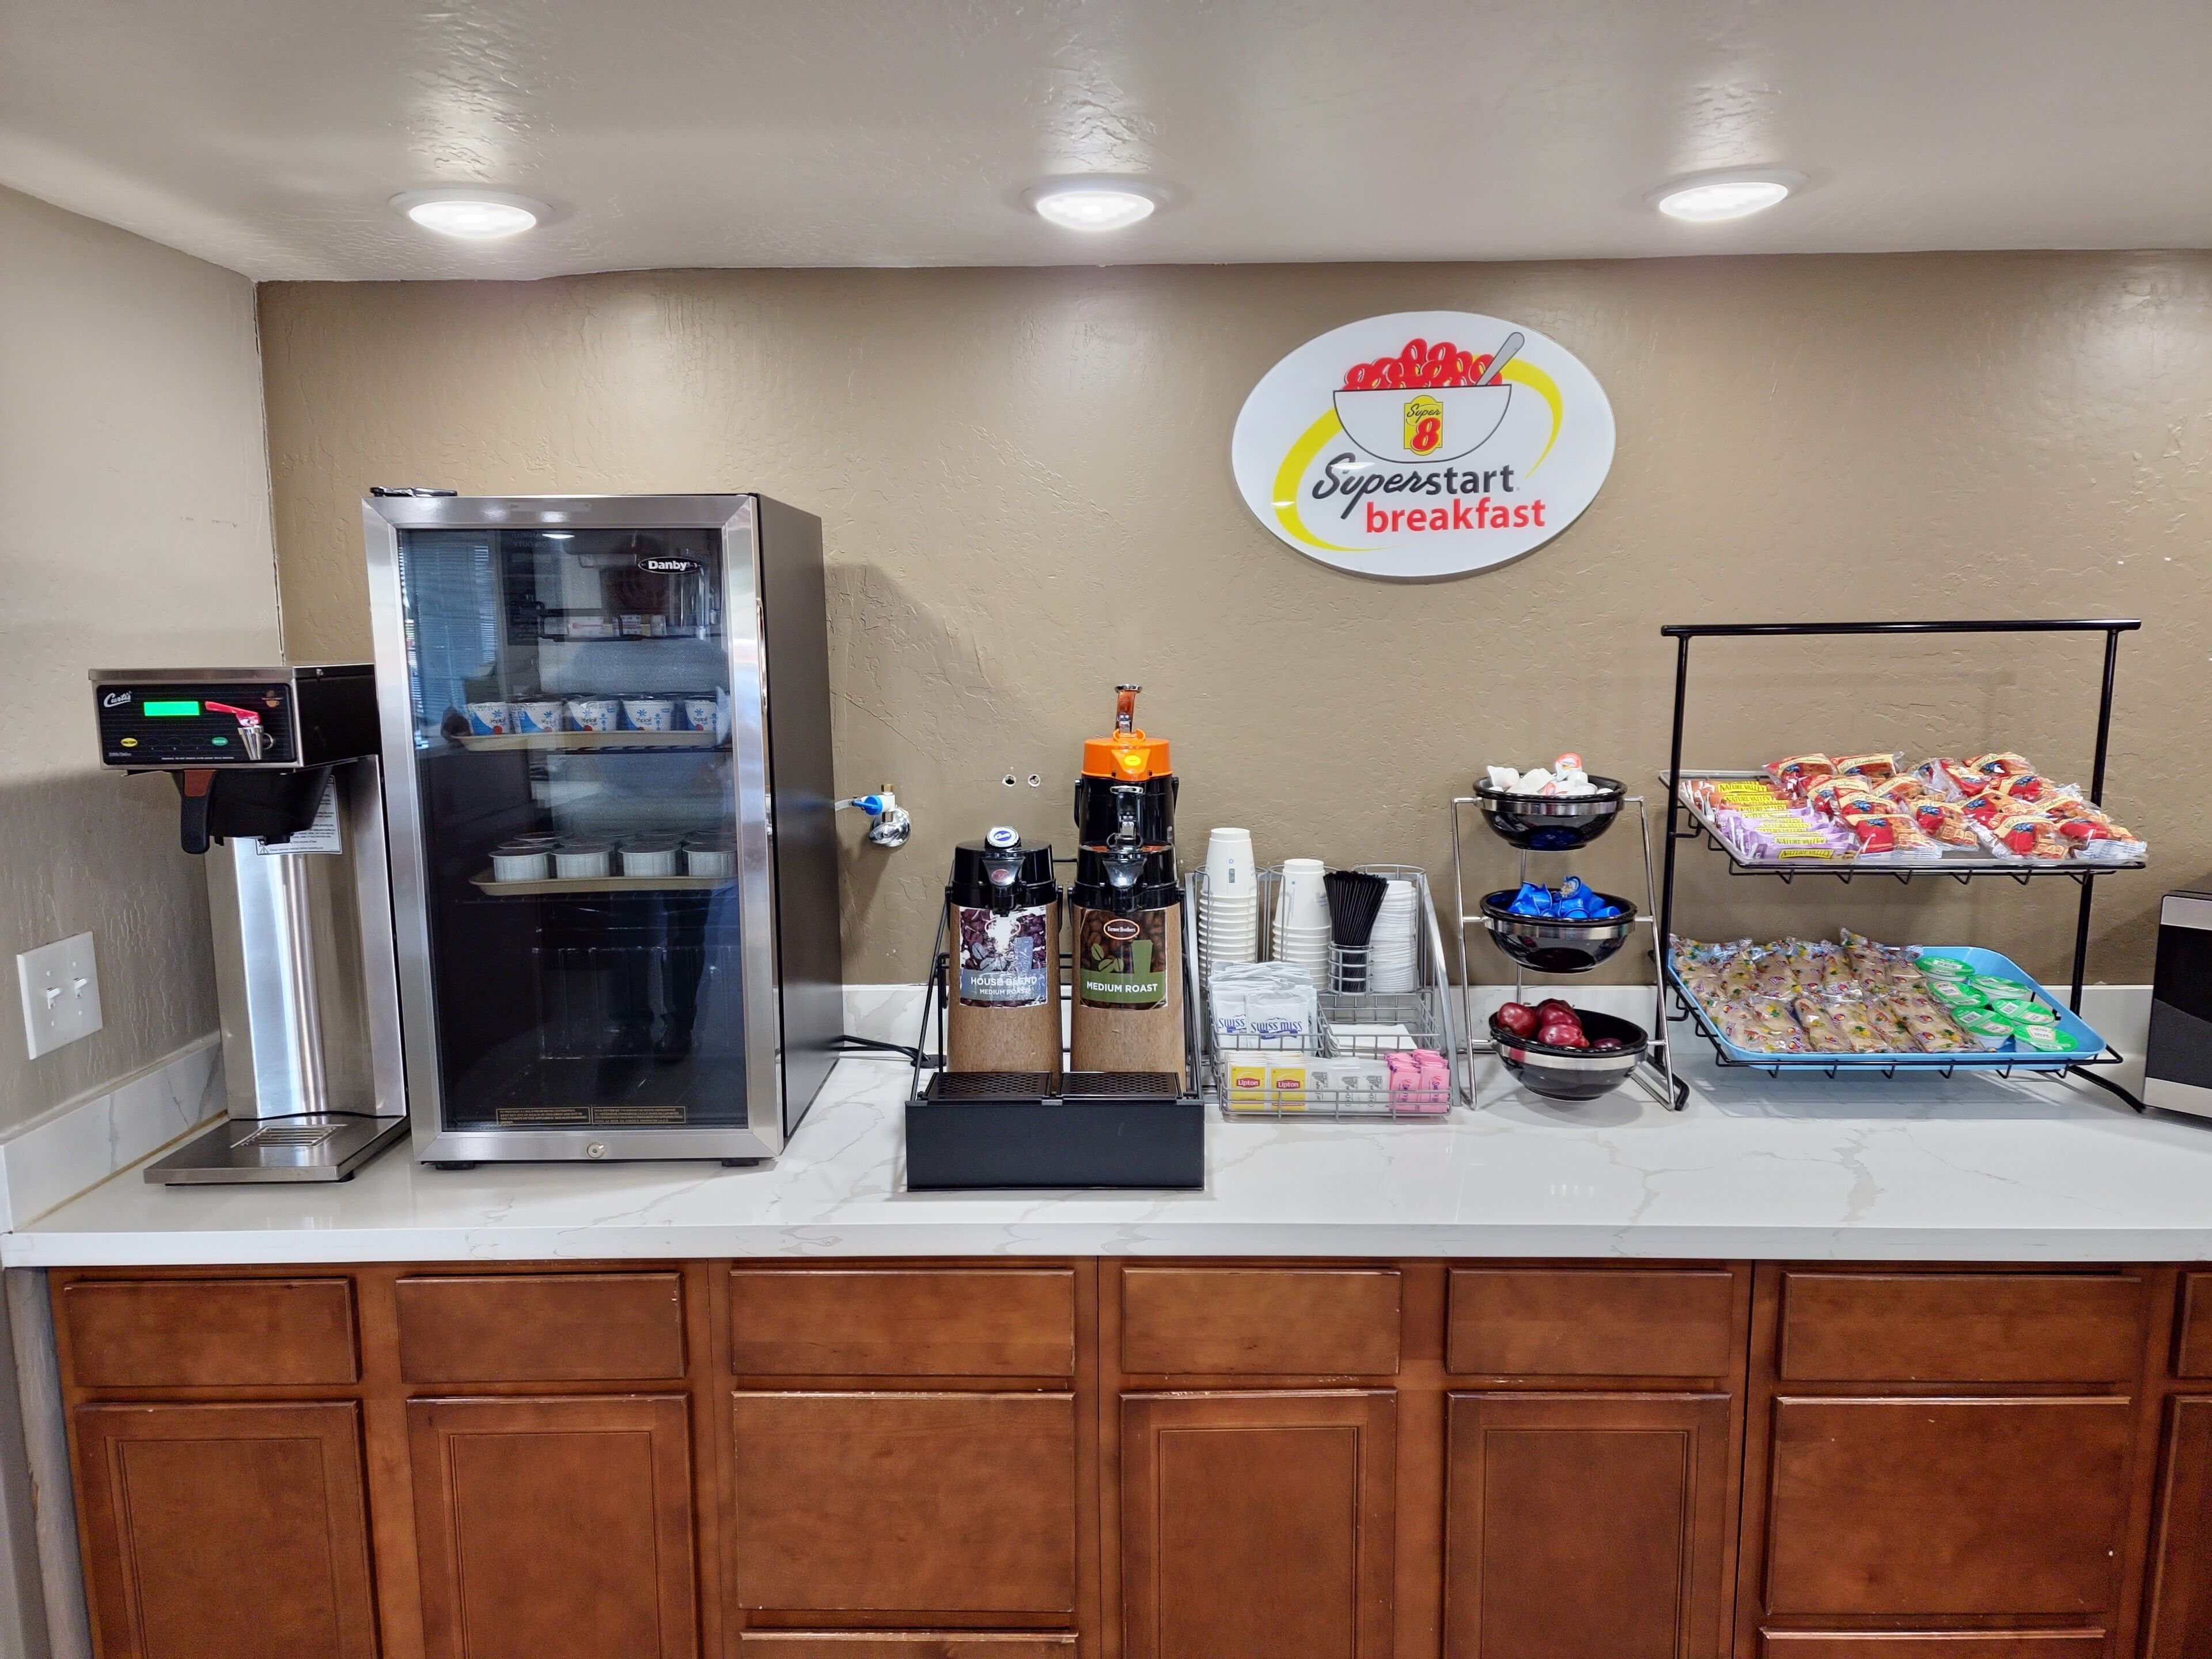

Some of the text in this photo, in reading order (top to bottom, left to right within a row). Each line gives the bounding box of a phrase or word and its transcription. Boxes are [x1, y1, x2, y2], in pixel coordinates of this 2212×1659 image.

[1407, 404, 1441, 423] Super
[1411, 417, 1441, 451] 8
[1312, 452, 1514, 520] Superstart
[1366, 497, 1546, 533] breakfast
[648, 560, 688, 571] Danby
[1744, 783, 1765, 791] VALLEY
[971, 976, 1037, 986] HOUSE BLEND
[1087, 982, 1158, 993] MEDIUM ROAST
[1218, 1018, 1245, 1028] SWISS
[1251, 1022, 1278, 1033] SWISS
